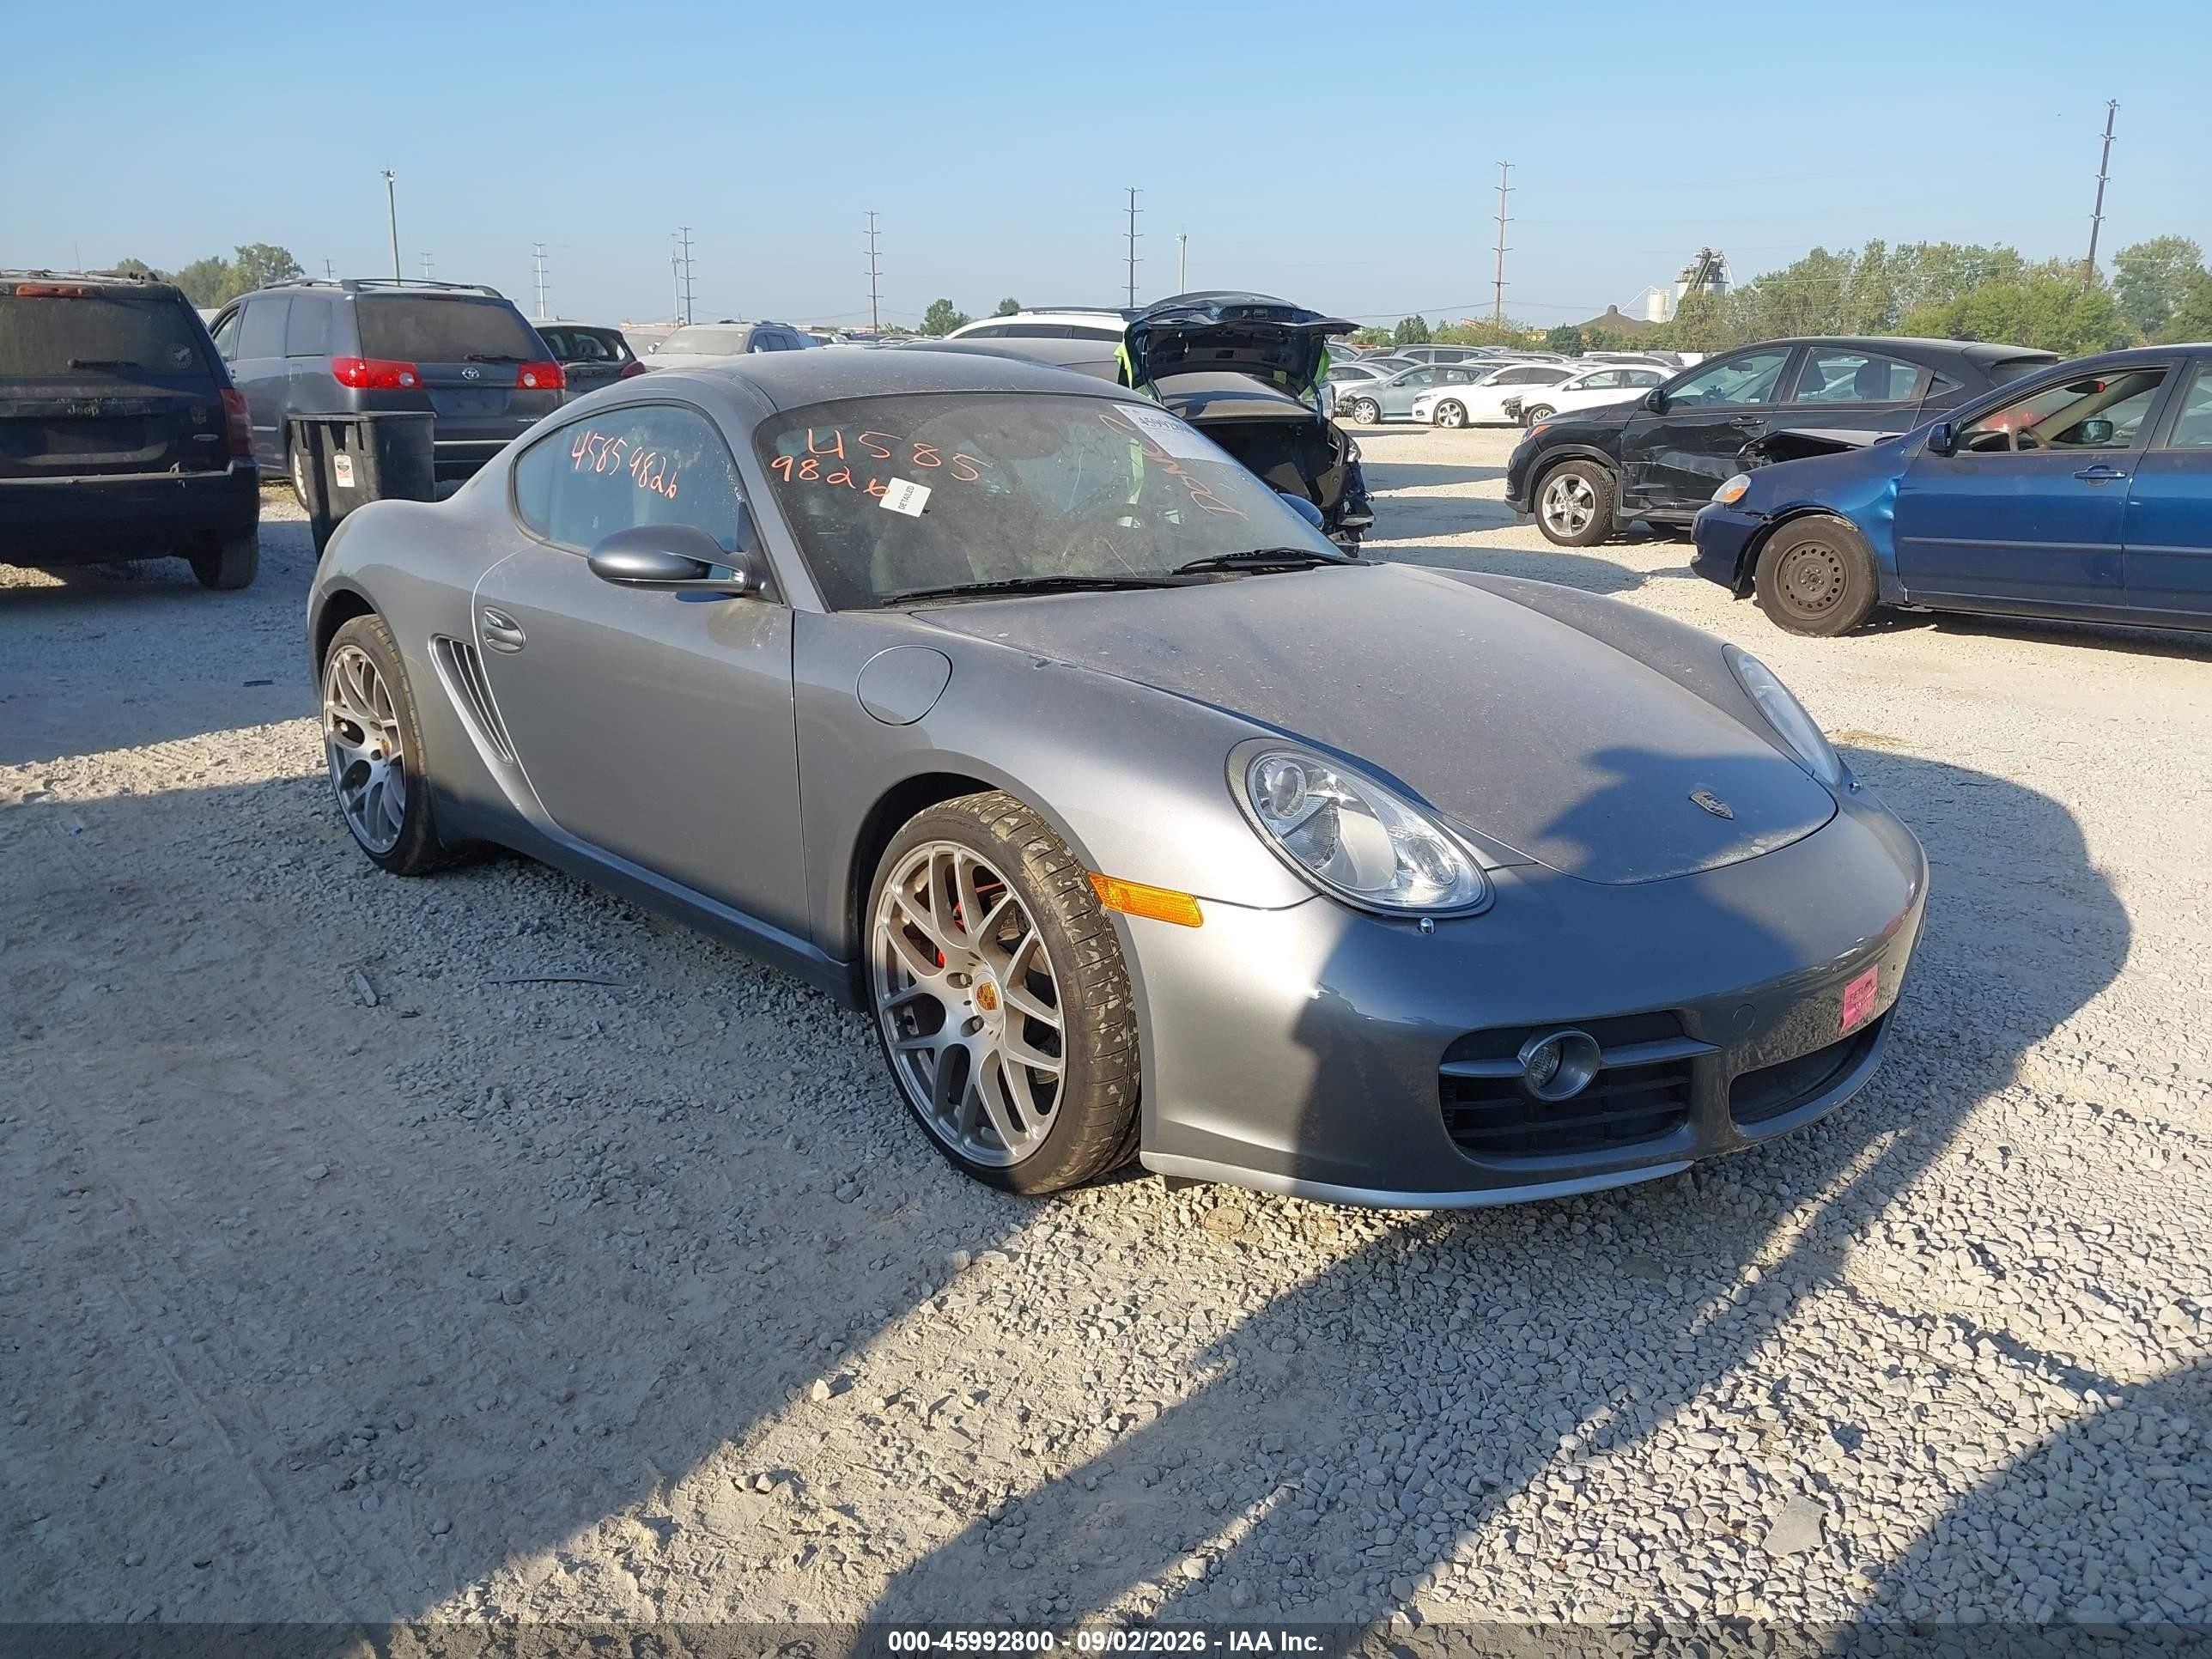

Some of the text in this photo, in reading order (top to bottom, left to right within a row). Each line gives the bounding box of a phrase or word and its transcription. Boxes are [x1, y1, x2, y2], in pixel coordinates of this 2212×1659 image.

[67, 404, 100, 416] Jeep
[571, 430, 629, 476] 4585
[806, 428, 993, 482] 4585
[770, 455, 890, 497] 9826
[897, 485, 915, 510] DETAILED
